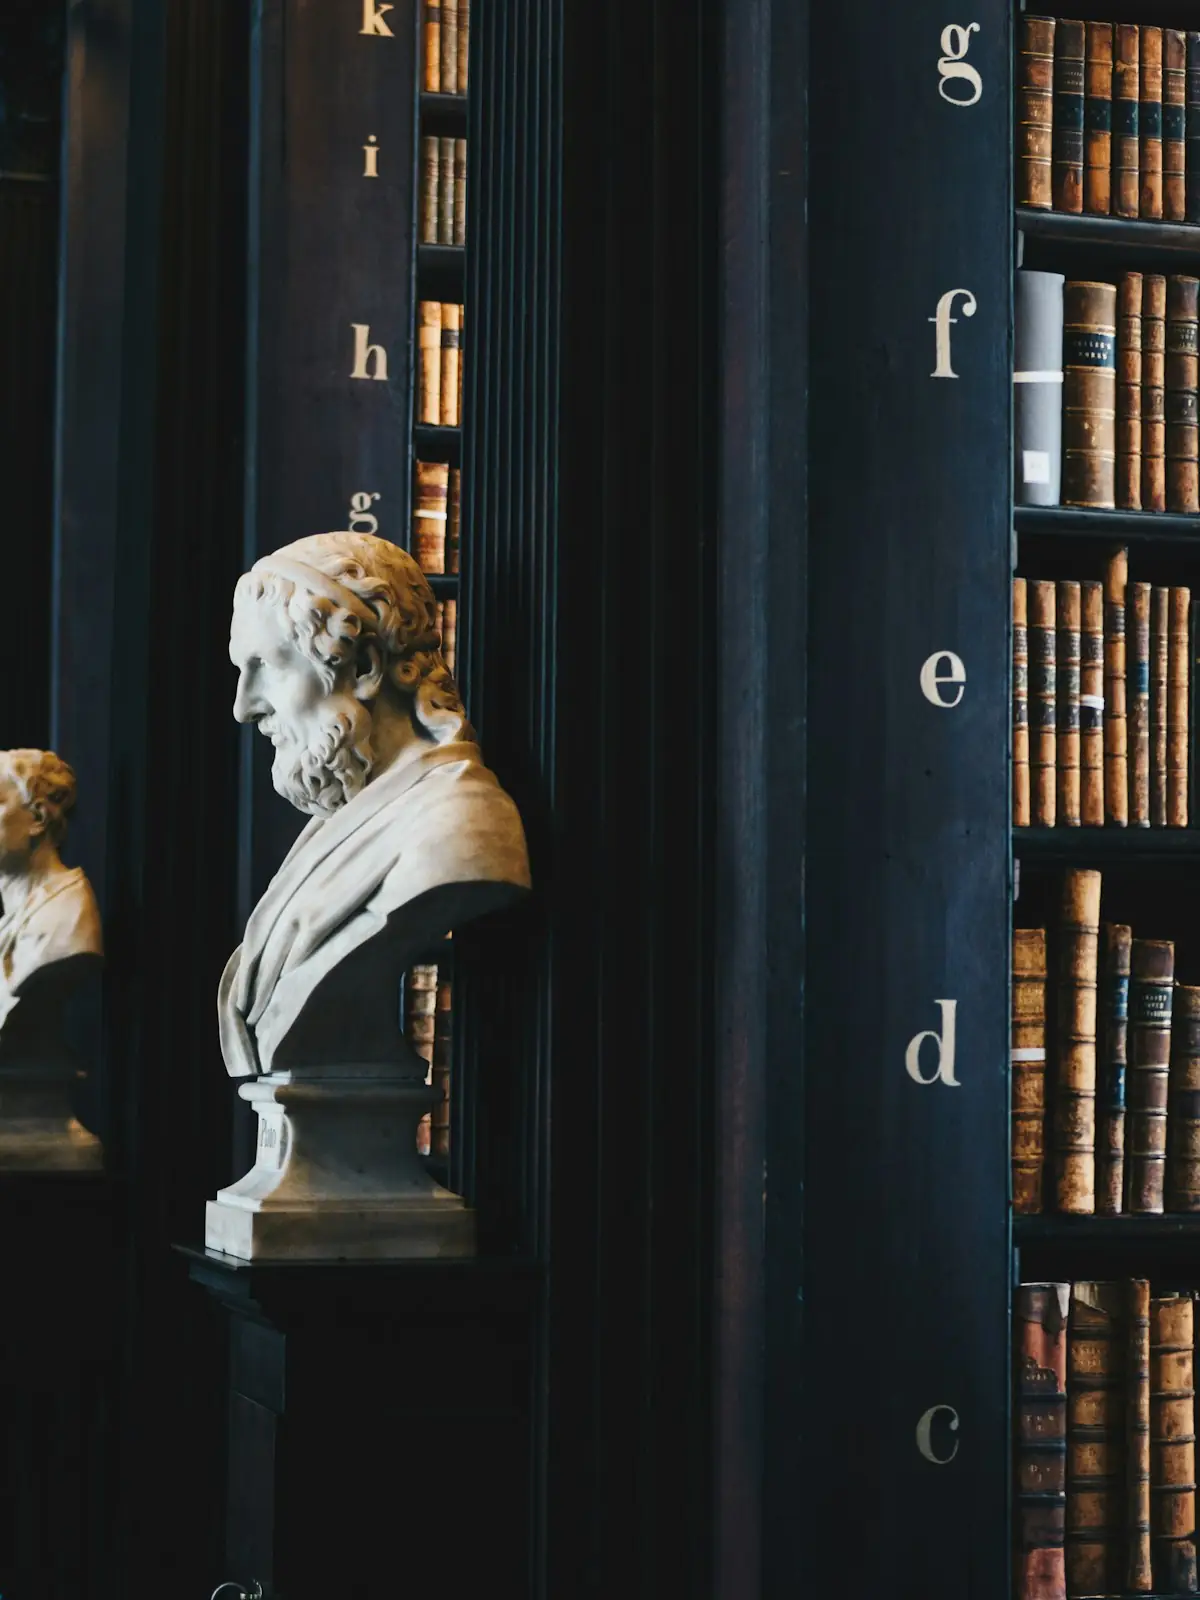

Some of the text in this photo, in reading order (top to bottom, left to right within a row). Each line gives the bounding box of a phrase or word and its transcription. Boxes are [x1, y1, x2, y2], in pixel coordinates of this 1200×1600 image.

[359, 0, 394, 37] k
[938, 22, 983, 107] g
[363, 135, 380, 178] i
[350, 323, 388, 381] h
[928, 288, 977, 379] f
[348, 491, 382, 534] g
[919, 651, 967, 708] e
[905, 998, 961, 1087] d
[916, 1405, 961, 1465] c
